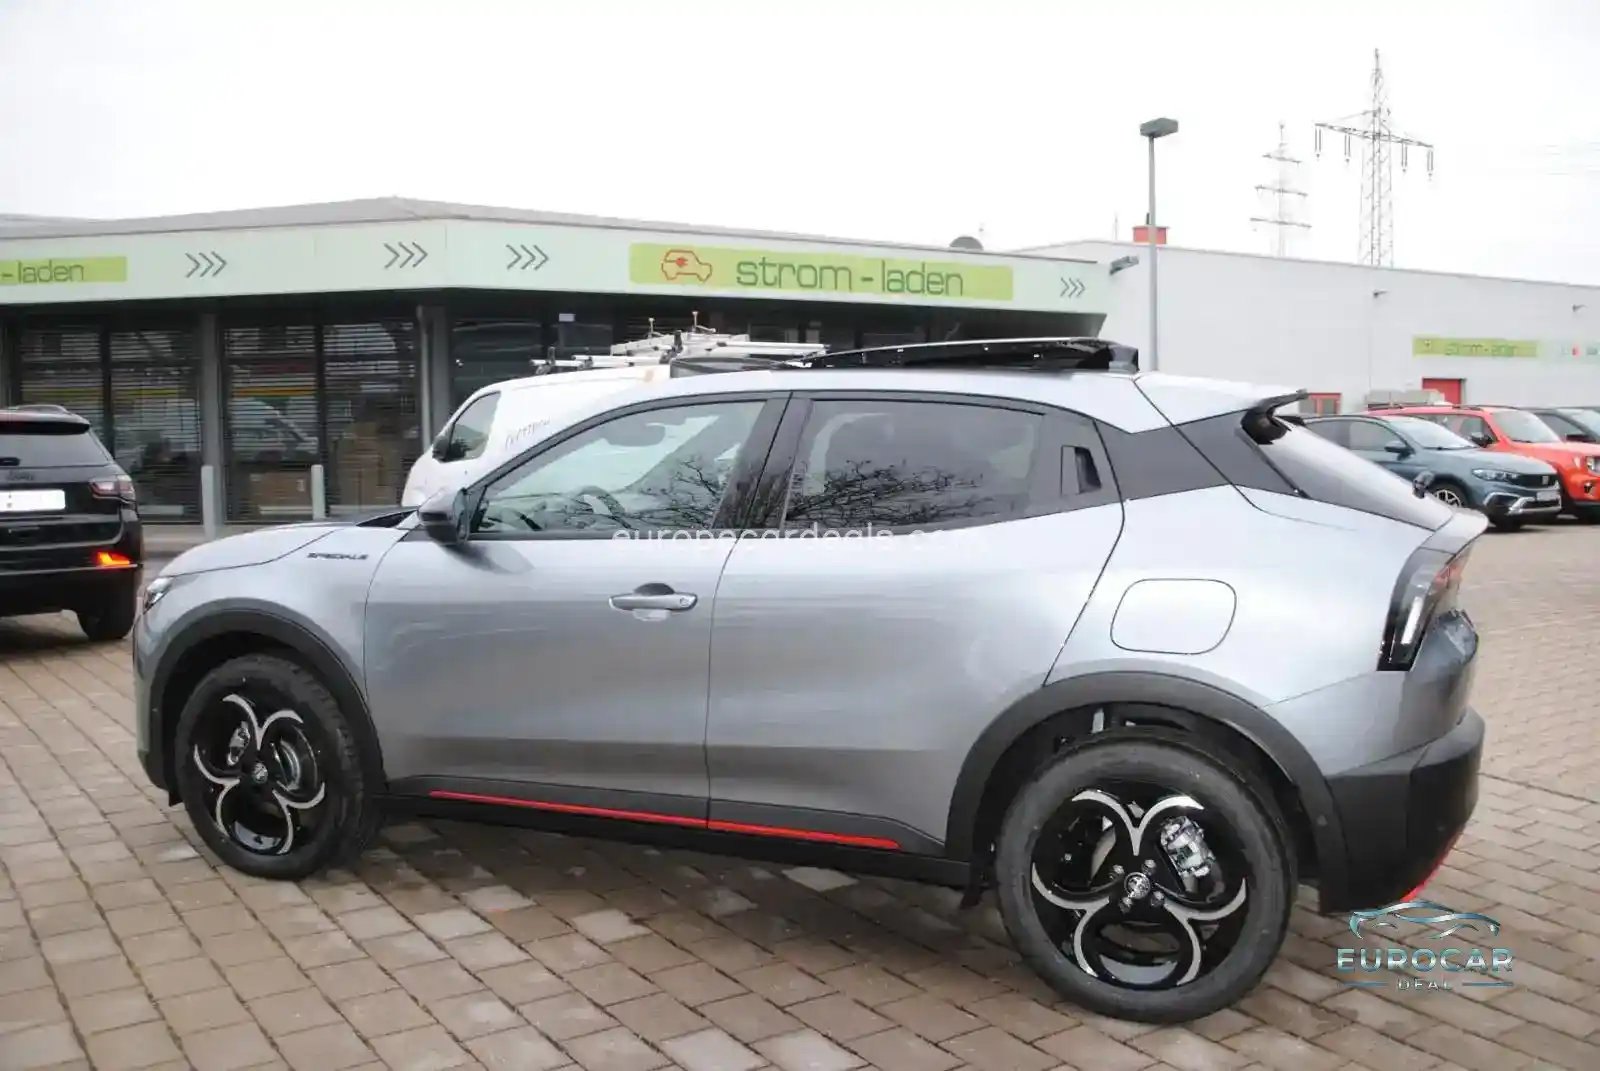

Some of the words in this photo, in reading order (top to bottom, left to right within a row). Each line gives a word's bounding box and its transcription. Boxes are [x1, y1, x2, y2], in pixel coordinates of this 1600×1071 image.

[18, 260, 84, 284] laden
[736, 257, 852, 291] strom
[881, 260, 963, 297] laden
